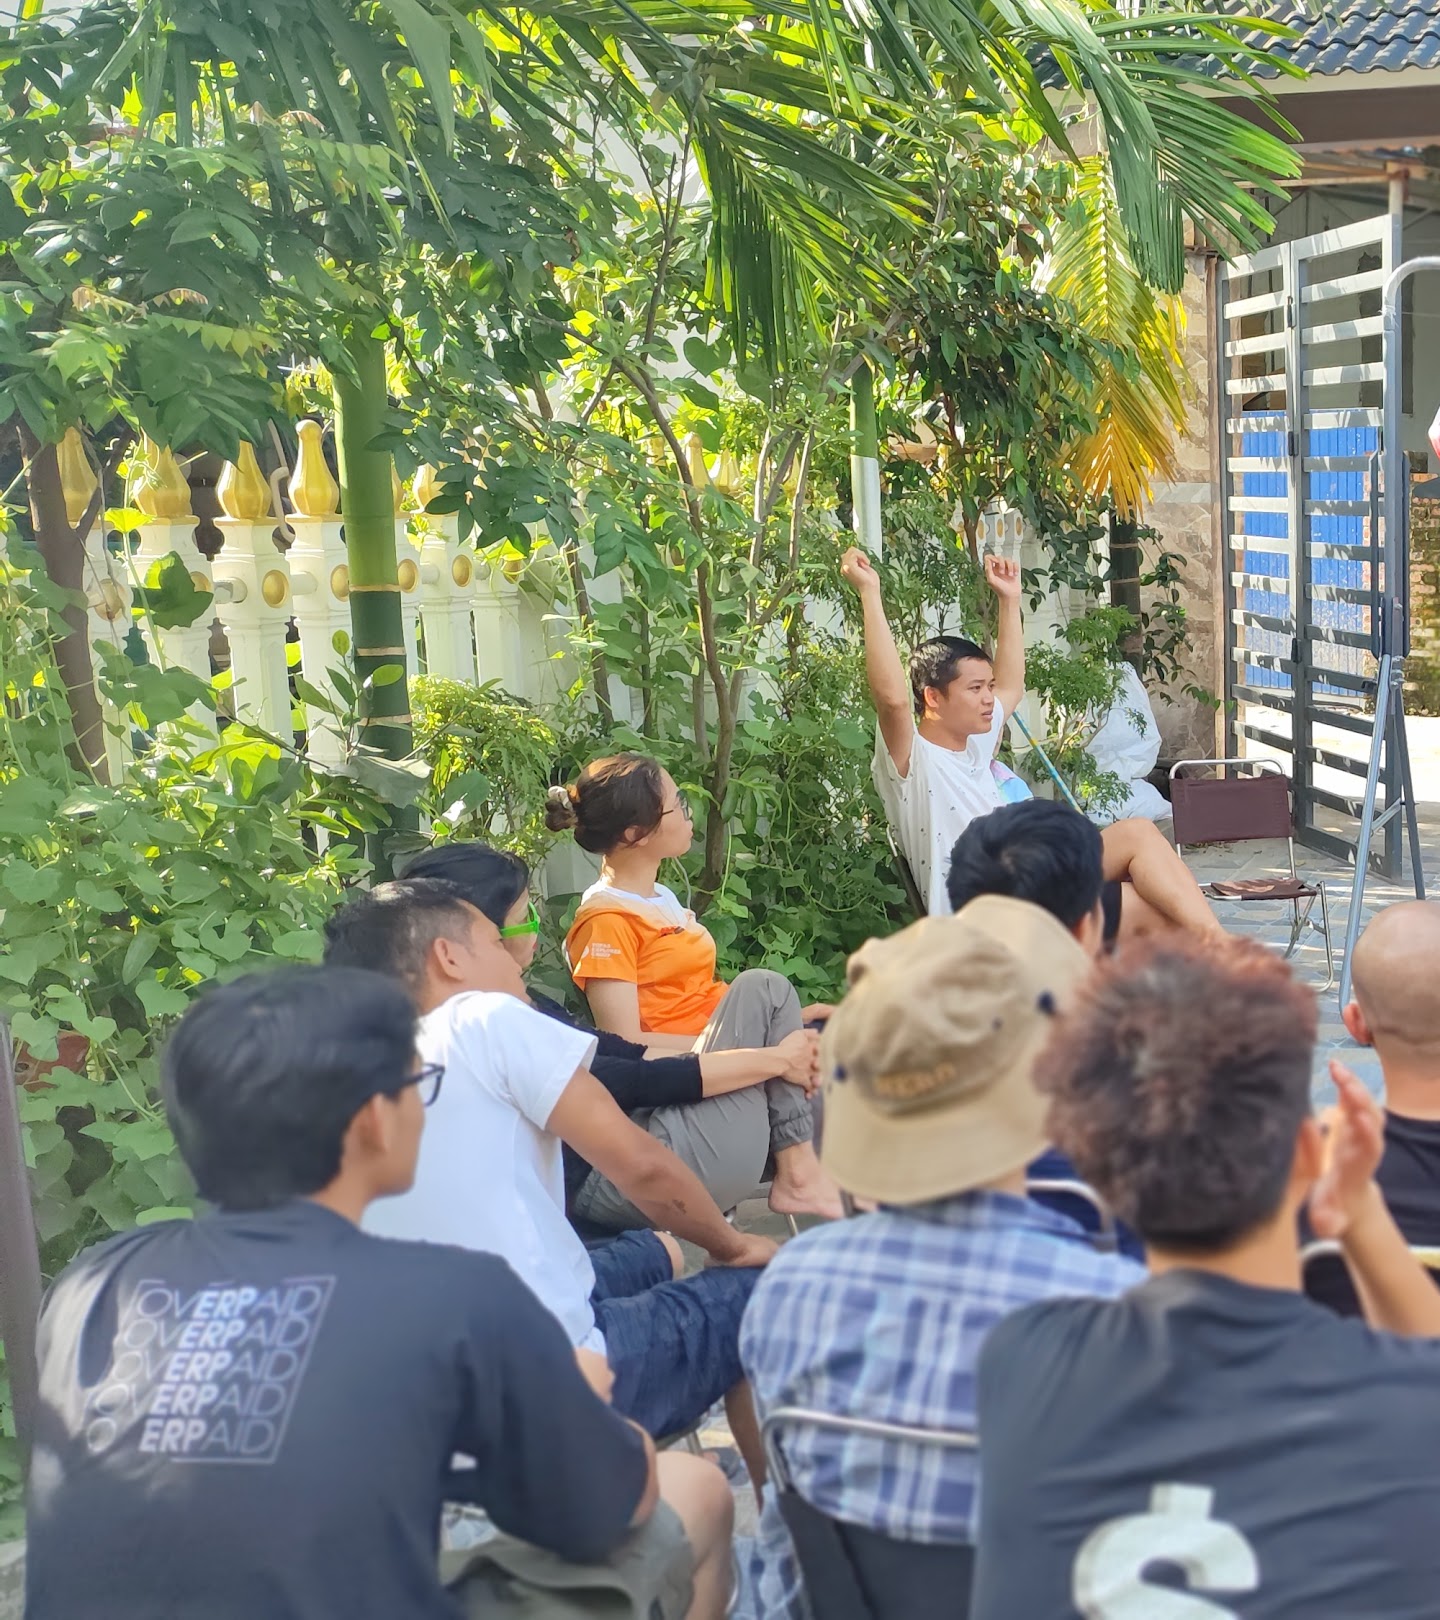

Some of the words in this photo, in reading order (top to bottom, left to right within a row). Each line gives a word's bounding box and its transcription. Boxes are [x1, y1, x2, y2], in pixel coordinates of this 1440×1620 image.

[136, 1285, 322, 1318] OVERPAID
[123, 1316, 310, 1349] OVERPAID
[112, 1349, 298, 1382] OVERPAID
[86, 1416, 275, 1454] OERPAID
